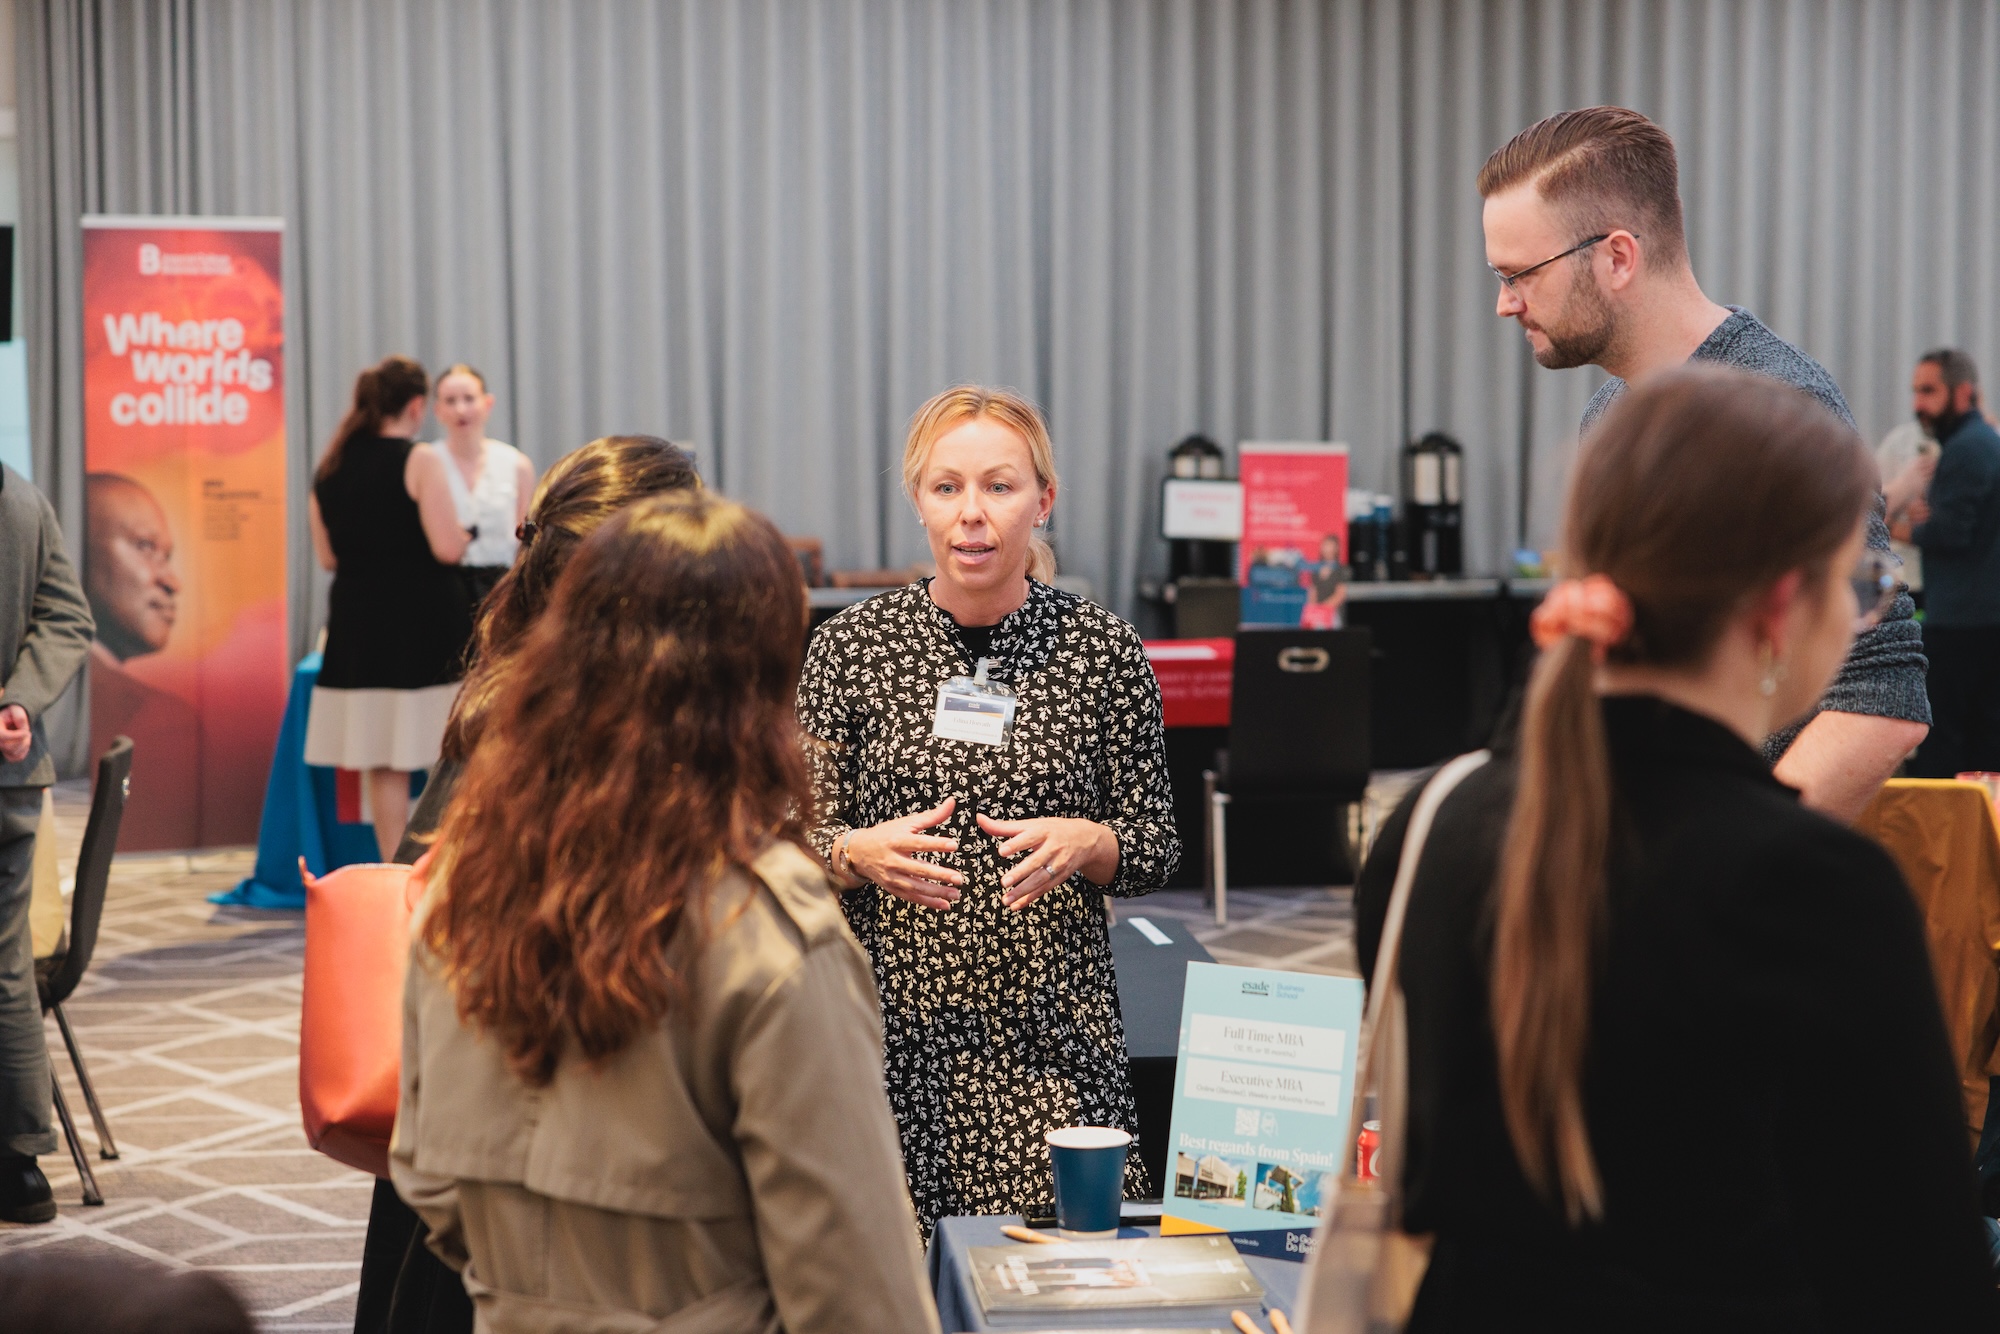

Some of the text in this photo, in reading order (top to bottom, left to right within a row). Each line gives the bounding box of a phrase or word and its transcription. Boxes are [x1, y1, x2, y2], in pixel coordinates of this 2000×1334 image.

[103, 312, 245, 355] Where
[131, 348, 273, 392] worlds
[110, 384, 248, 426] collide
[1241, 980, 1270, 992] esade
[1276, 982, 1305, 993] Business
[1276, 990, 1299, 1000] School
[1223, 1026, 1304, 1047] Full Time MBA
[1220, 1070, 1304, 1092] Executive MBA
[1179, 1132, 1334, 1168] Best regards from Spain!
[1285, 1241, 1317, 1255] Do Bett
[1286, 1231, 1320, 1246] Do Goo
